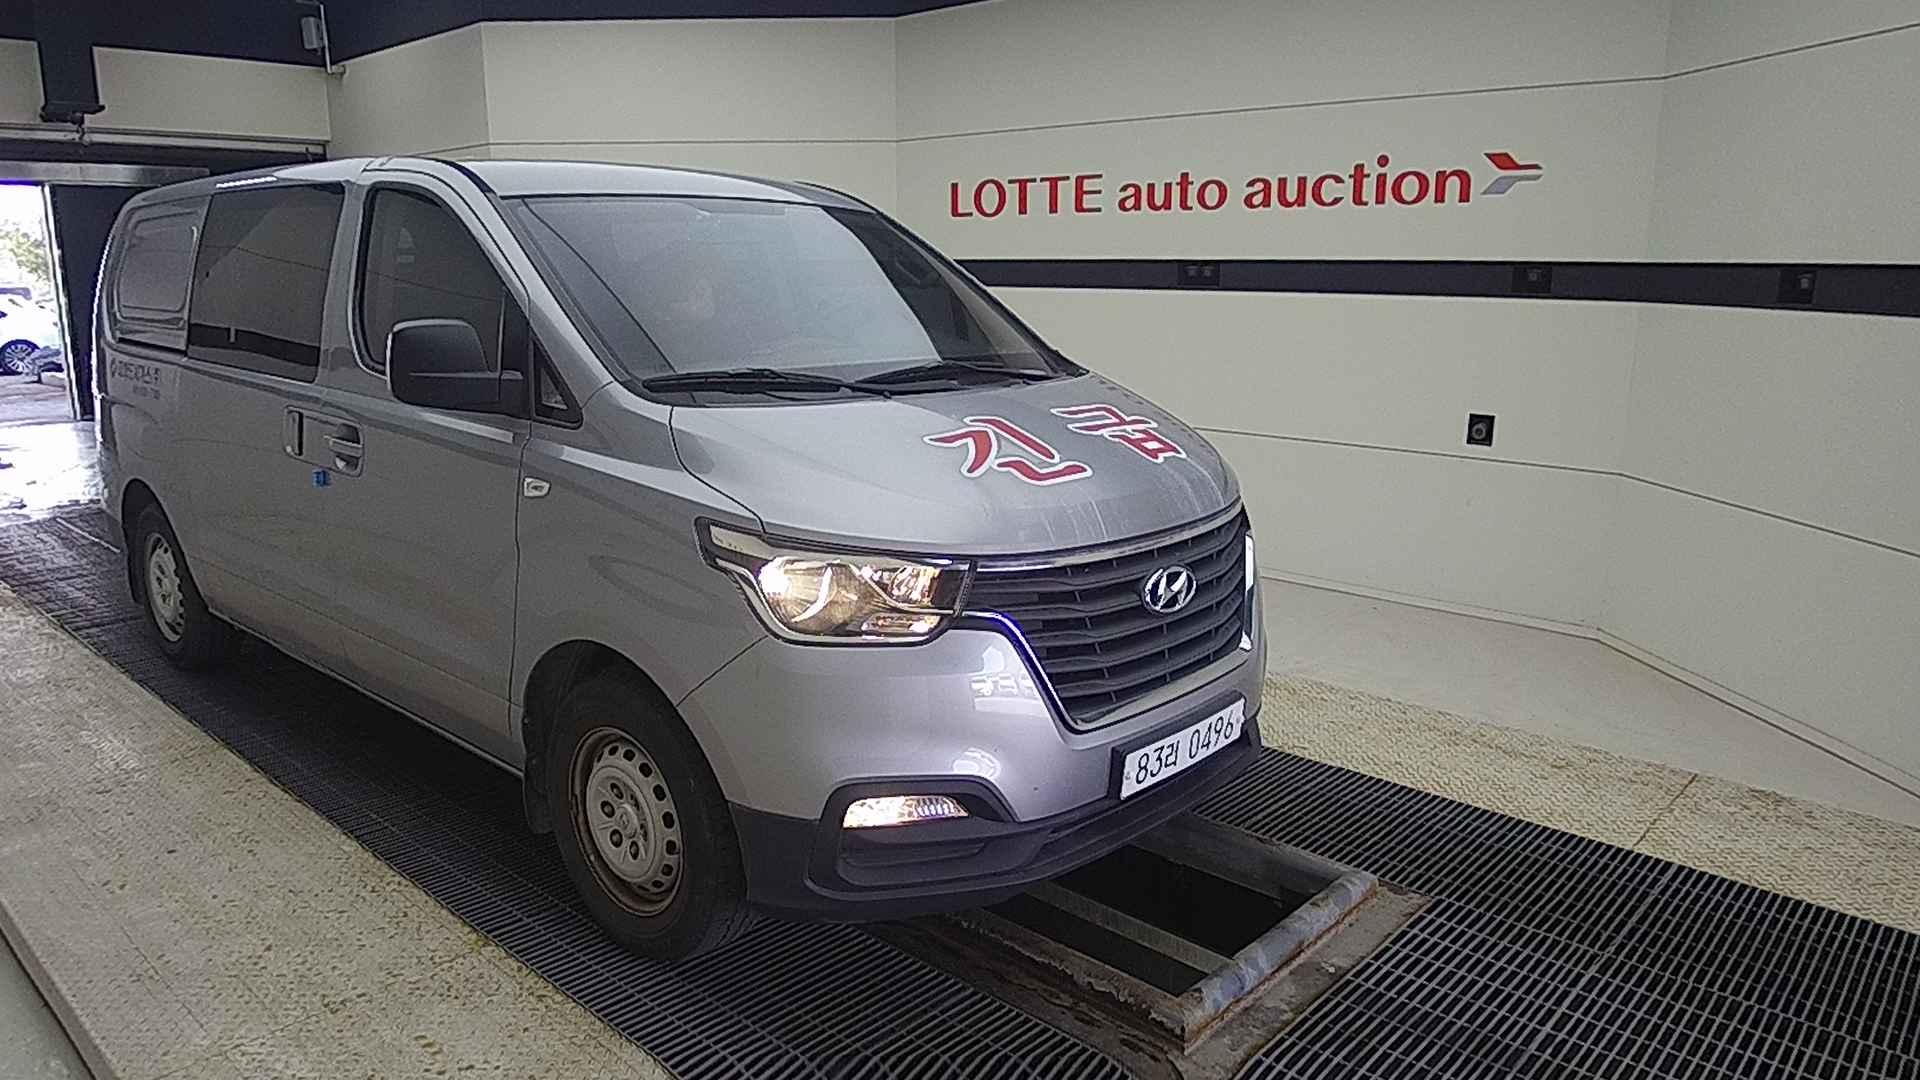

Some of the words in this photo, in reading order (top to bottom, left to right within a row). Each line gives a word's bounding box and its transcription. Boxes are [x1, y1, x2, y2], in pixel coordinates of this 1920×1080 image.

[950, 173, 1104, 218] LOTTE
[1117, 171, 1228, 213] auto
[1243, 153, 1472, 209] auction
[924, 404, 1187, 484] 긴급
[1188, 709, 1234, 760] 0496
